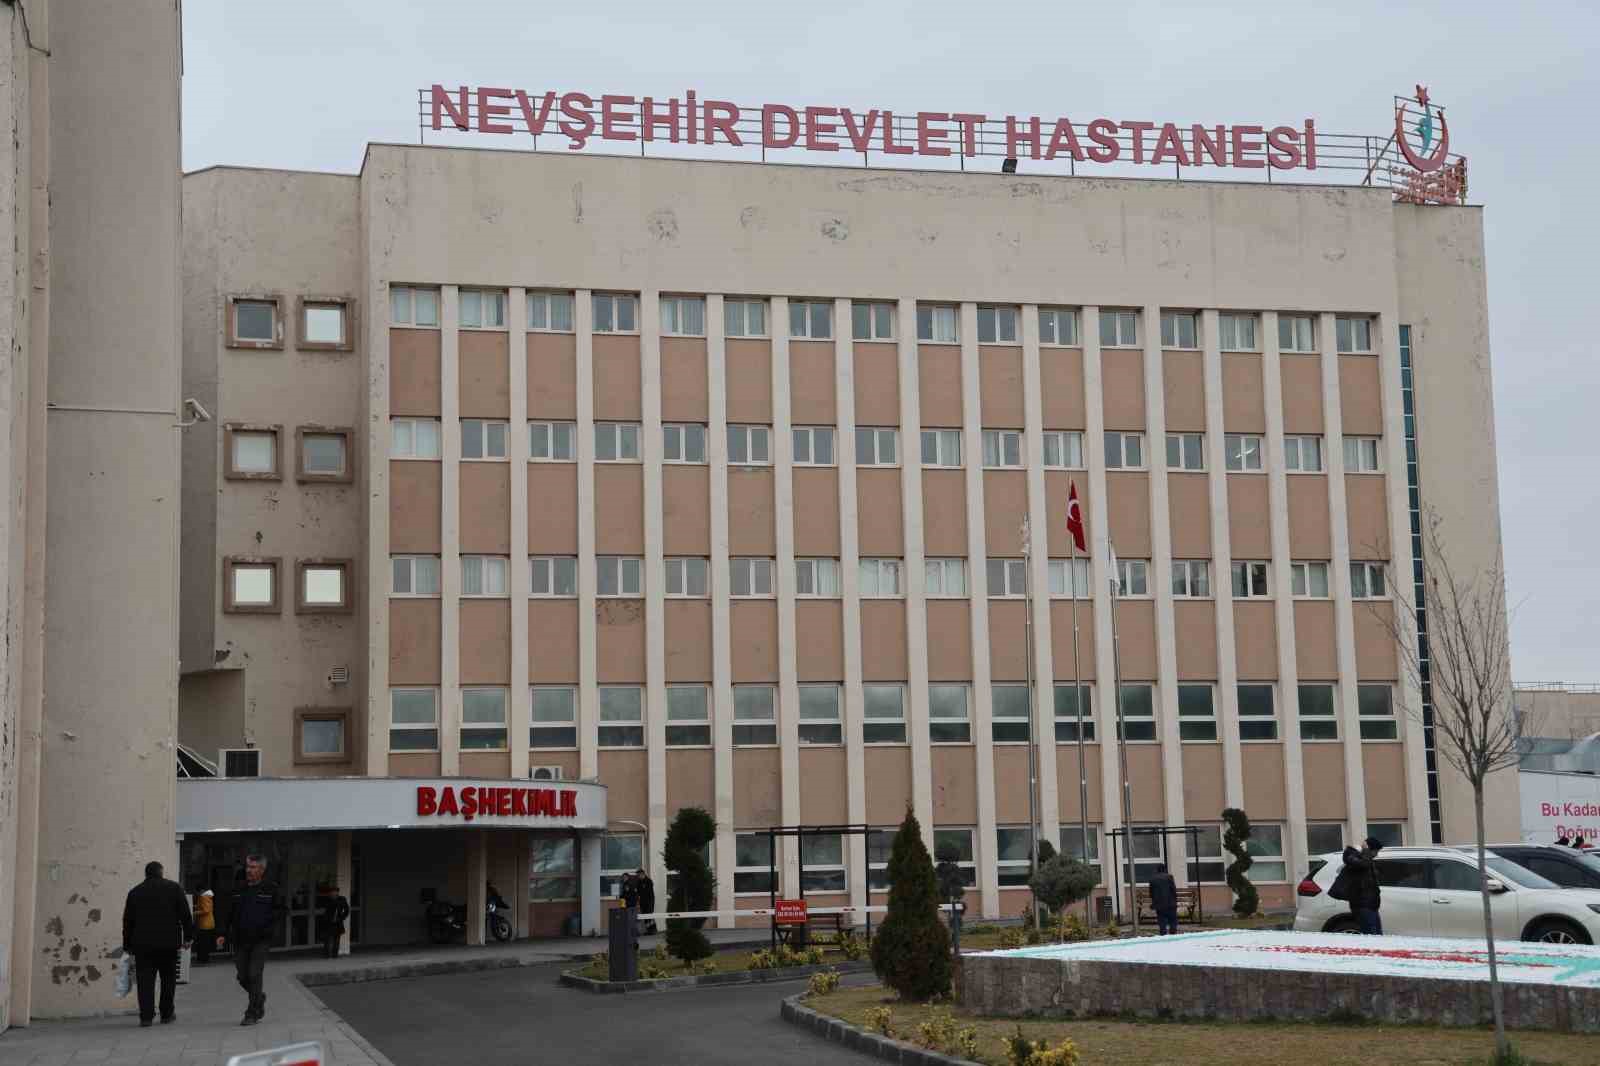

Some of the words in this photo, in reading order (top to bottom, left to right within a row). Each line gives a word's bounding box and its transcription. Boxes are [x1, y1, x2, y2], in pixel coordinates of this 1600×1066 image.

[431, 84, 744, 151] NEVŞEHİR
[762, 103, 986, 157] DEVLET
[1006, 115, 1318, 171] HASTANESİ
[417, 786, 577, 821] BAŞHEKİMLİK
[1541, 802, 1559, 817] Bu
